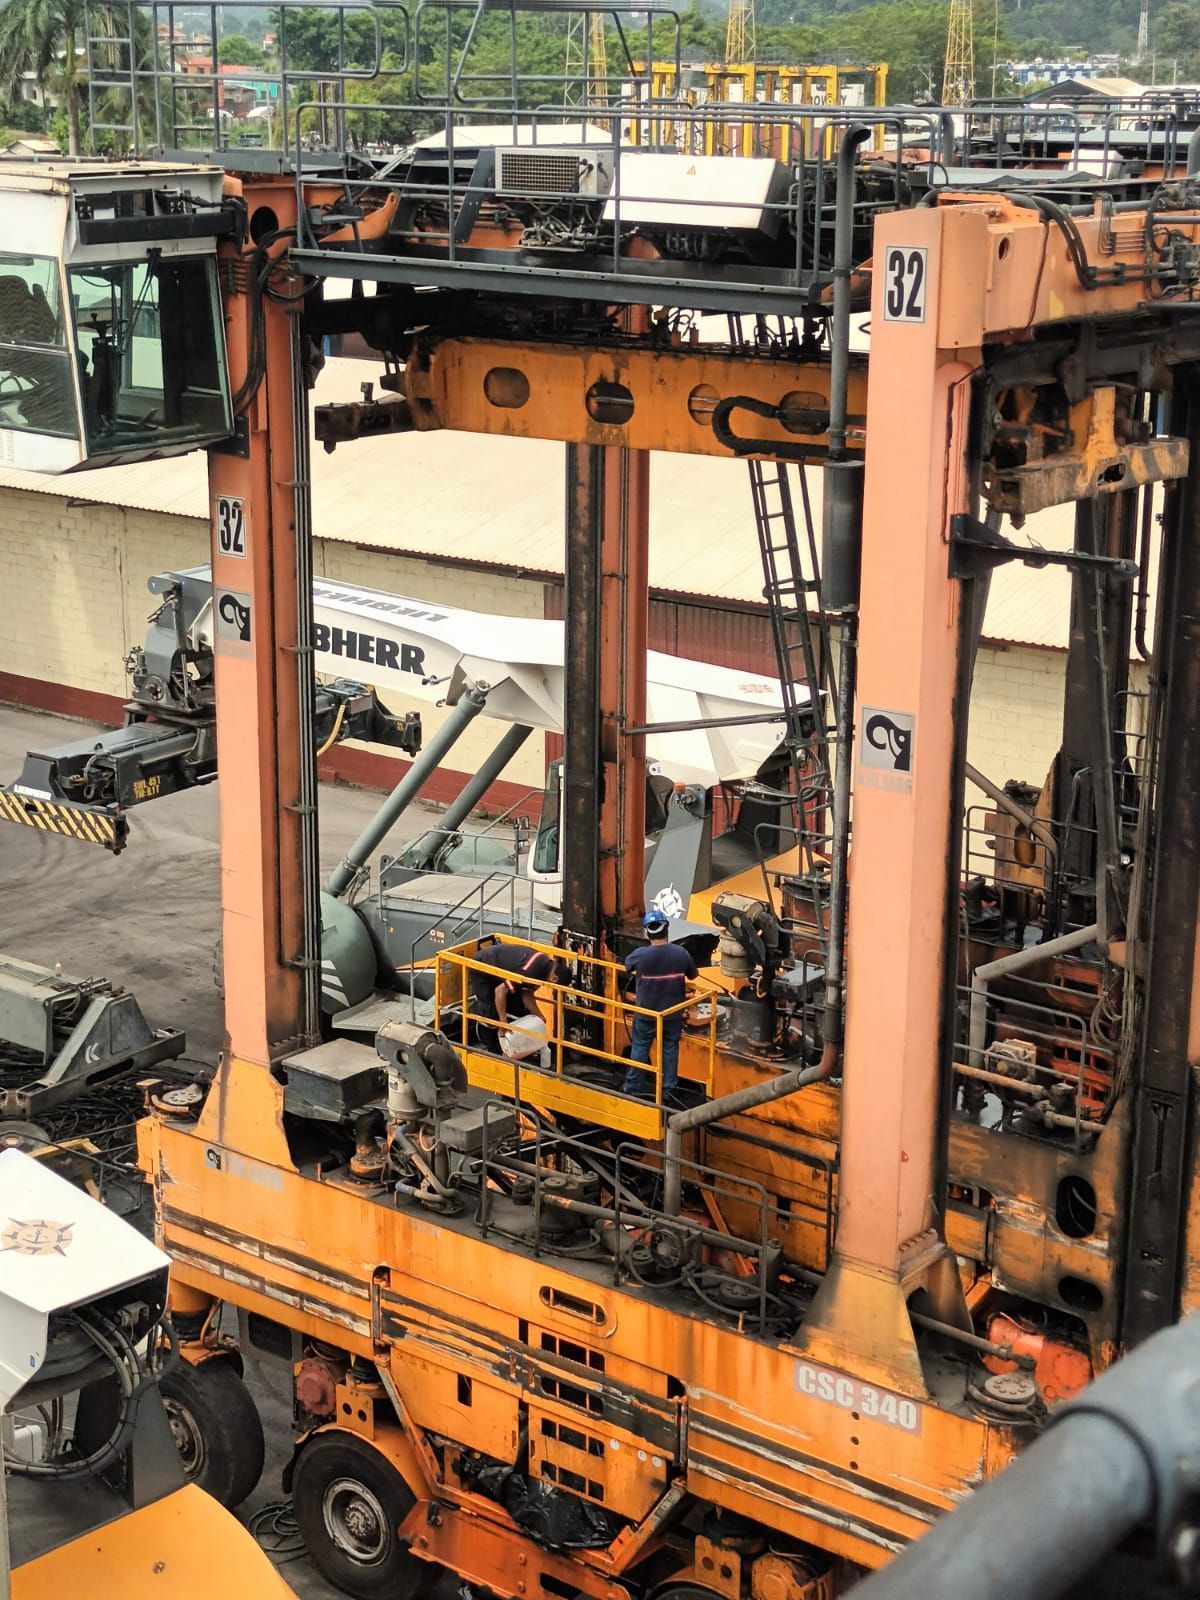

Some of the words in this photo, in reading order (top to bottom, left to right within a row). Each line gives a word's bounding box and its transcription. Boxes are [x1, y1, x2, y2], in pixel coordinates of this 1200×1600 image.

[888, 250, 923, 317] 32
[219, 499, 243, 553] 32
[313, 622, 426, 677] BHERR
[798, 1365, 855, 1408] CSC
[860, 1386, 917, 1430] 340
